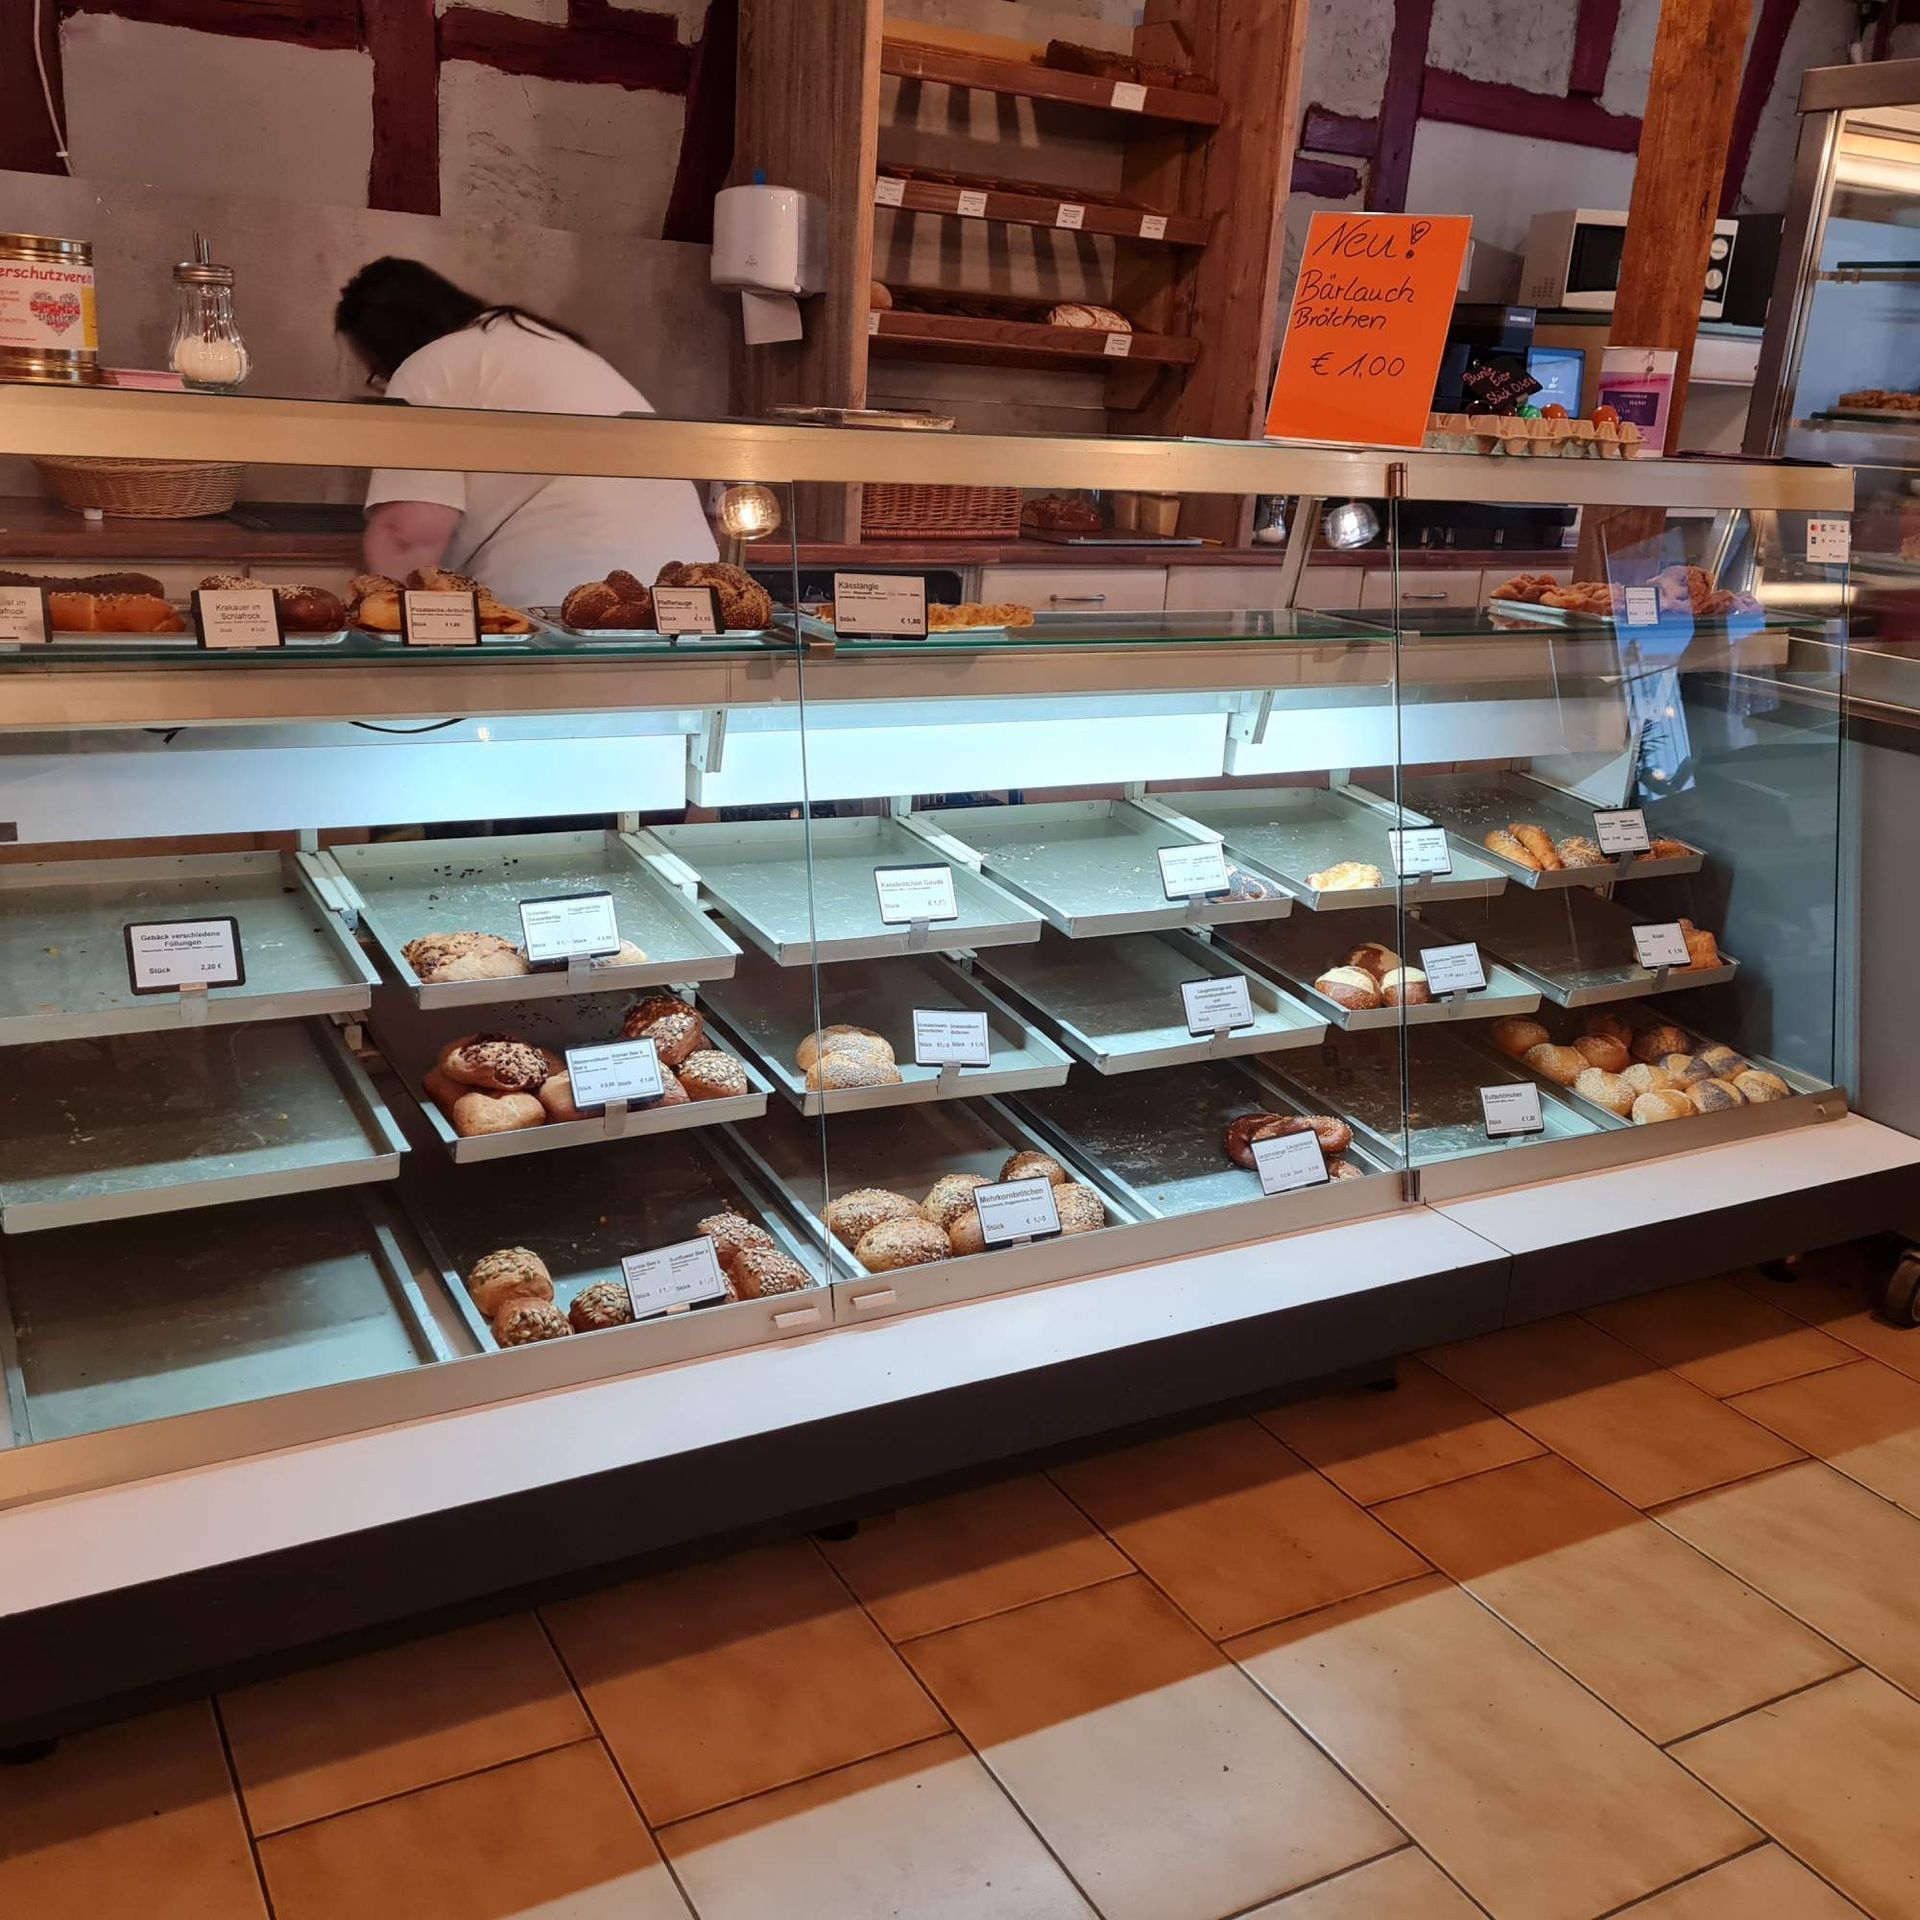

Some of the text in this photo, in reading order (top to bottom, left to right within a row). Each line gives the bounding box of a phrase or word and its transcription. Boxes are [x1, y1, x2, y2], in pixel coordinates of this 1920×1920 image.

[1297, 269, 1414, 305] Bärlauch
[1294, 306, 1387, 330] Brötchen
[1310, 352, 1335, 376] €
[1490, 371, 1511, 387] Eier
[216, 603, 250, 611] Krakauer
[220, 611, 261, 620] Schlafrock
[140, 931, 221, 942] Gebäck verschiedene
[164, 939, 202, 948] Füllungen
[148, 966, 171, 975] Stück
[200, 963, 216, 971] 2,20
[979, 1187, 1044, 1203] Mehrkornbrötchen
[986, 1222, 1004, 1232] Stück
